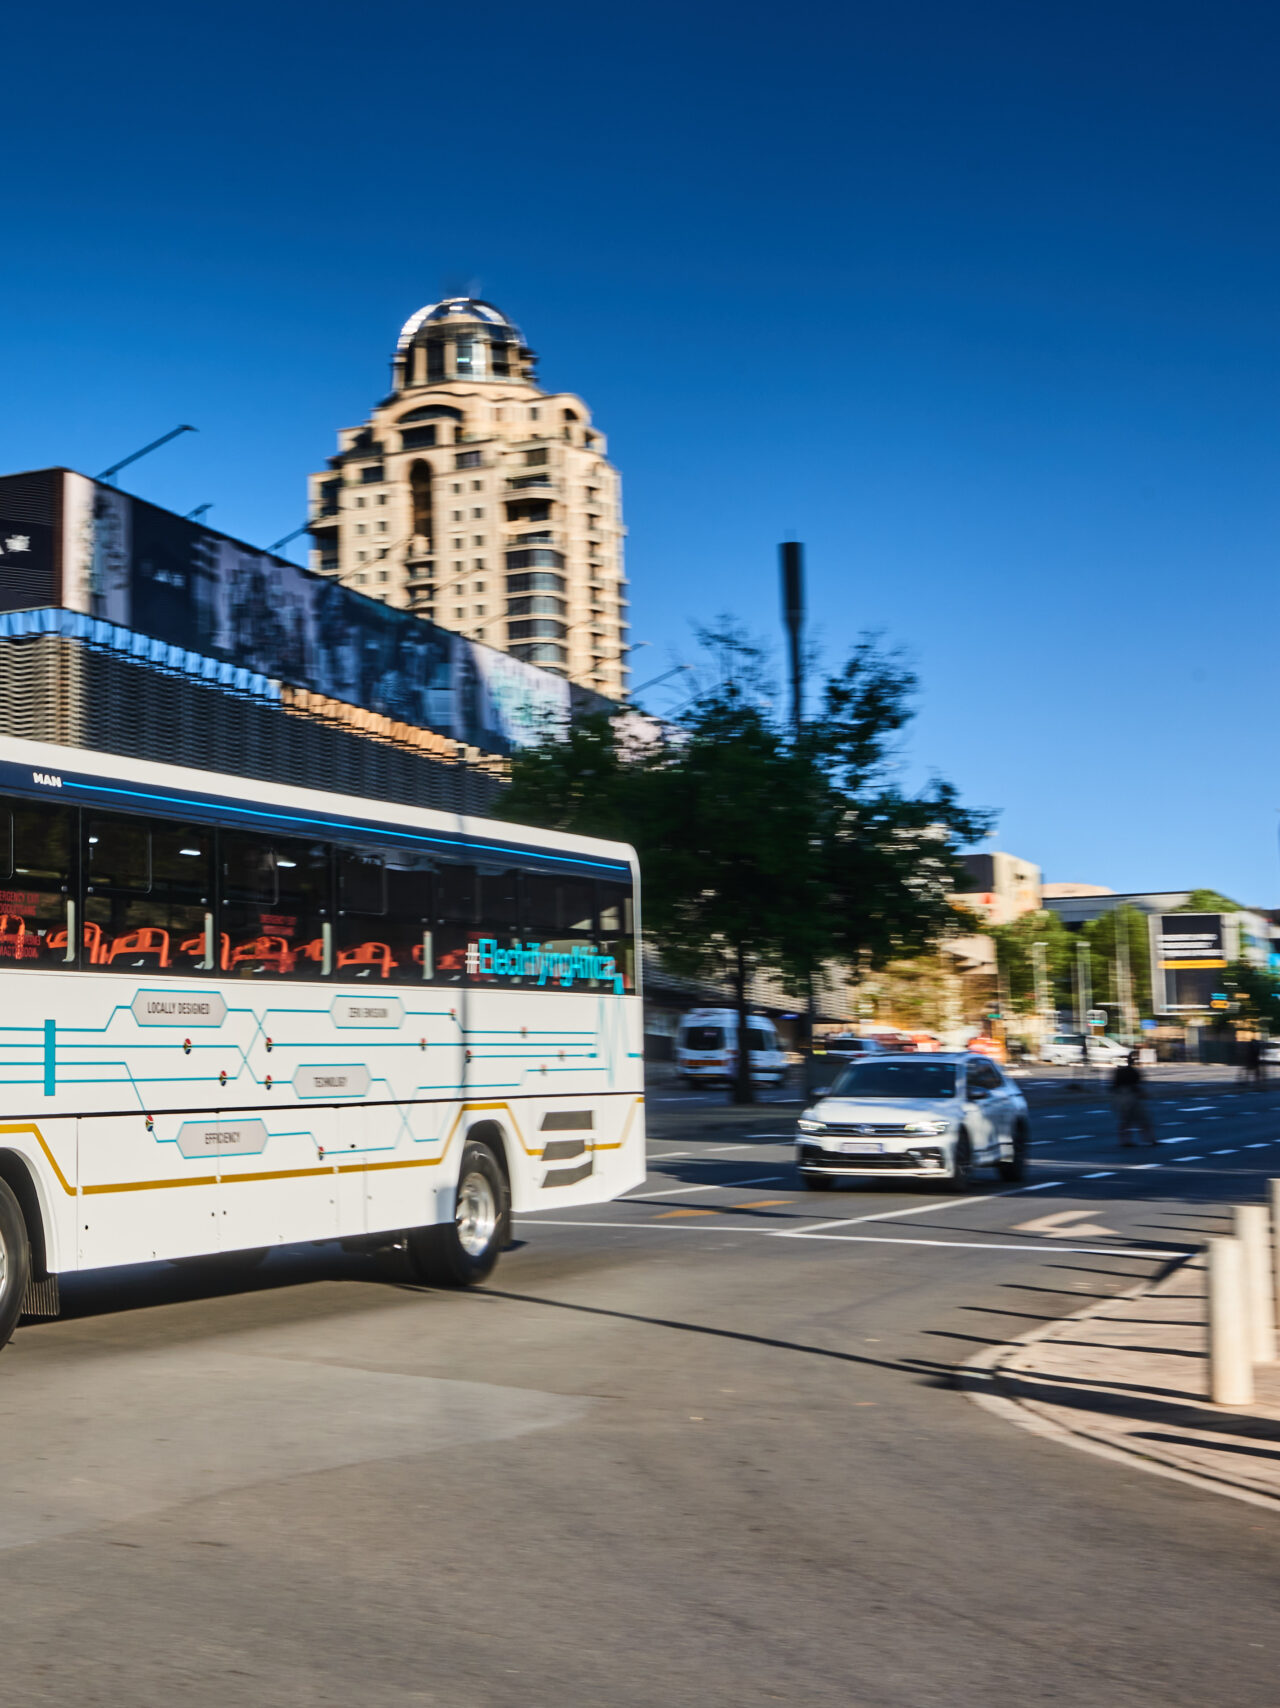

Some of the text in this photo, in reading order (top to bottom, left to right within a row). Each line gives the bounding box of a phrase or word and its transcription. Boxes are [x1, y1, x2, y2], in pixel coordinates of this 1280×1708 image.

[32, 771, 62, 788] MAN
[147, 1001, 210, 1015] LOCALLY DESIGNED
[204, 1131, 240, 1145] EFFICIENCY
